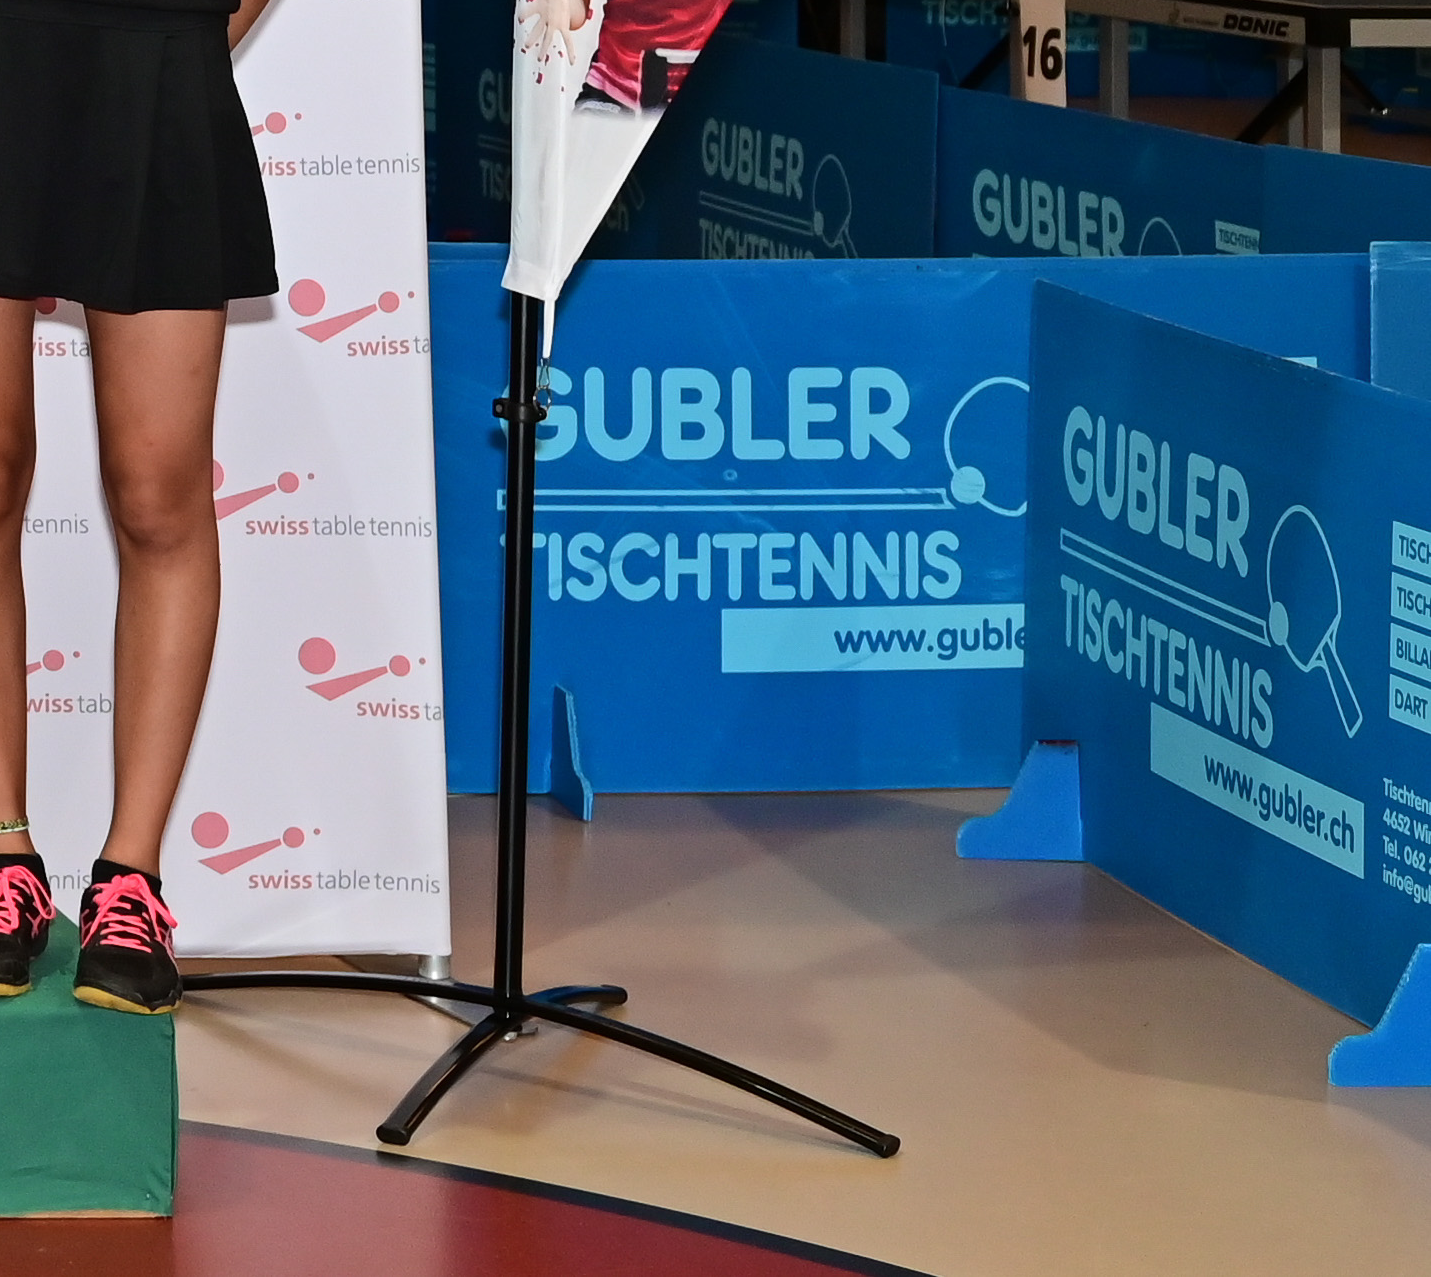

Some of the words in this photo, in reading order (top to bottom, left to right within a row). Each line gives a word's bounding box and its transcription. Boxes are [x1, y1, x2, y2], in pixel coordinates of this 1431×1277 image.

[1223, 13, 1289, 37] DONIC
[1022, 25, 1064, 81] 16
[700, 117, 805, 201] GUBLER
[972, 168, 1125, 257] GUBLER
[500, 366, 911, 462] GUBLER
[1062, 405, 1250, 577] GUBLER
[246, 515, 308, 535] swiss
[834, 619, 1026, 661] www.guble
[1060, 574, 1274, 749] TISCHTENNIS
[1394, 687, 1428, 720] DART
[1204, 754, 1356, 854] www.gubler.ch
[1383, 808, 1411, 837] 4652
[1383, 835, 1401, 860] Tel.
[1404, 845, 1426, 873] 062
[249, 870, 312, 889] swiss
